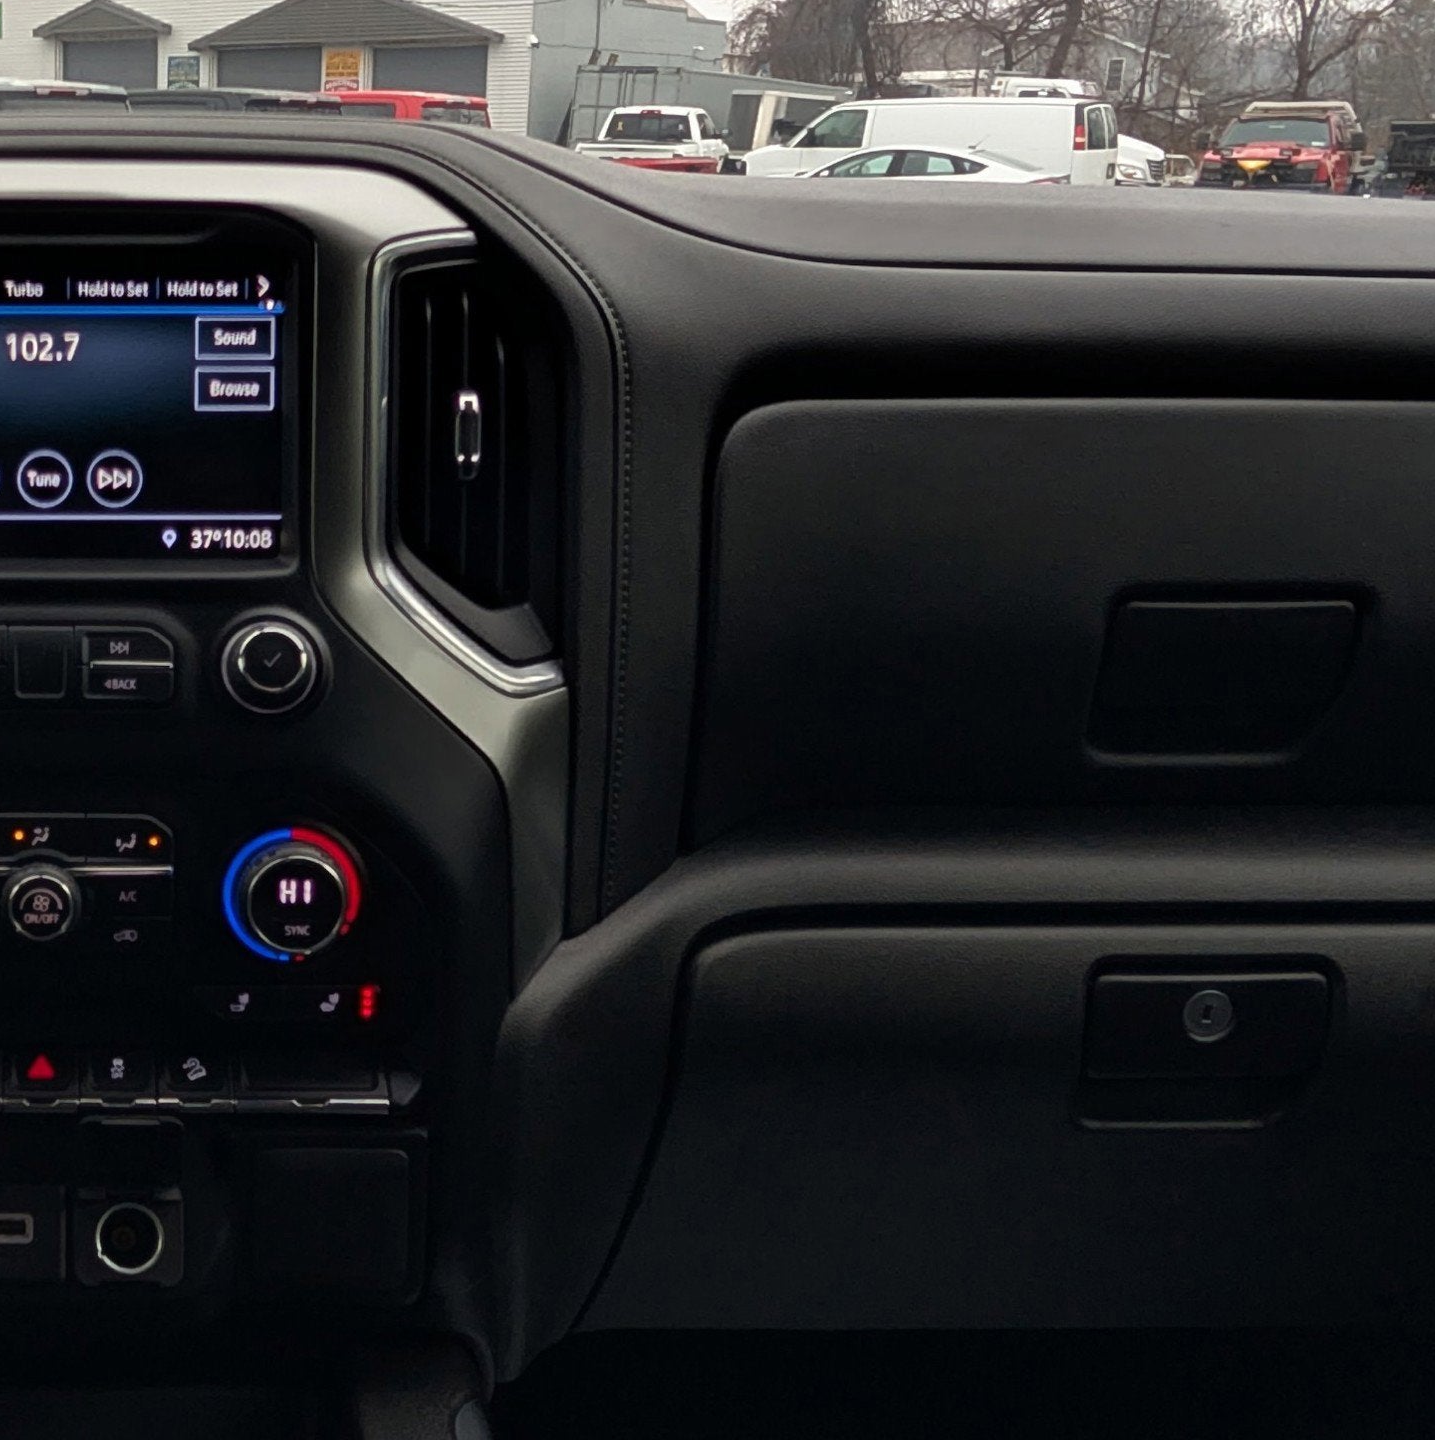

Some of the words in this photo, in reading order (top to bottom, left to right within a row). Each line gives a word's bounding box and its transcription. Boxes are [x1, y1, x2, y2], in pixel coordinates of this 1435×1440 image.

[3, 279, 44, 298] Turbo
[77, 280, 108, 298] Hold
[111, 281, 125, 298] to
[127, 281, 149, 298] Set
[166, 280, 197, 298] Hold
[200, 281, 214, 298] to
[216, 280, 238, 298] Set
[213, 328, 257, 346] Sound
[5, 332, 81, 362] 102.7
[209, 379, 261, 398] Browse
[27, 471, 61, 488] Tune
[224, 530, 273, 550] 10:08
[111, 677, 137, 691] BACK
[118, 890, 137, 903] A/C
[278, 879, 313, 905] HI
[22, 913, 60, 925] ON/OFF
[284, 924, 311, 937] SYNC
